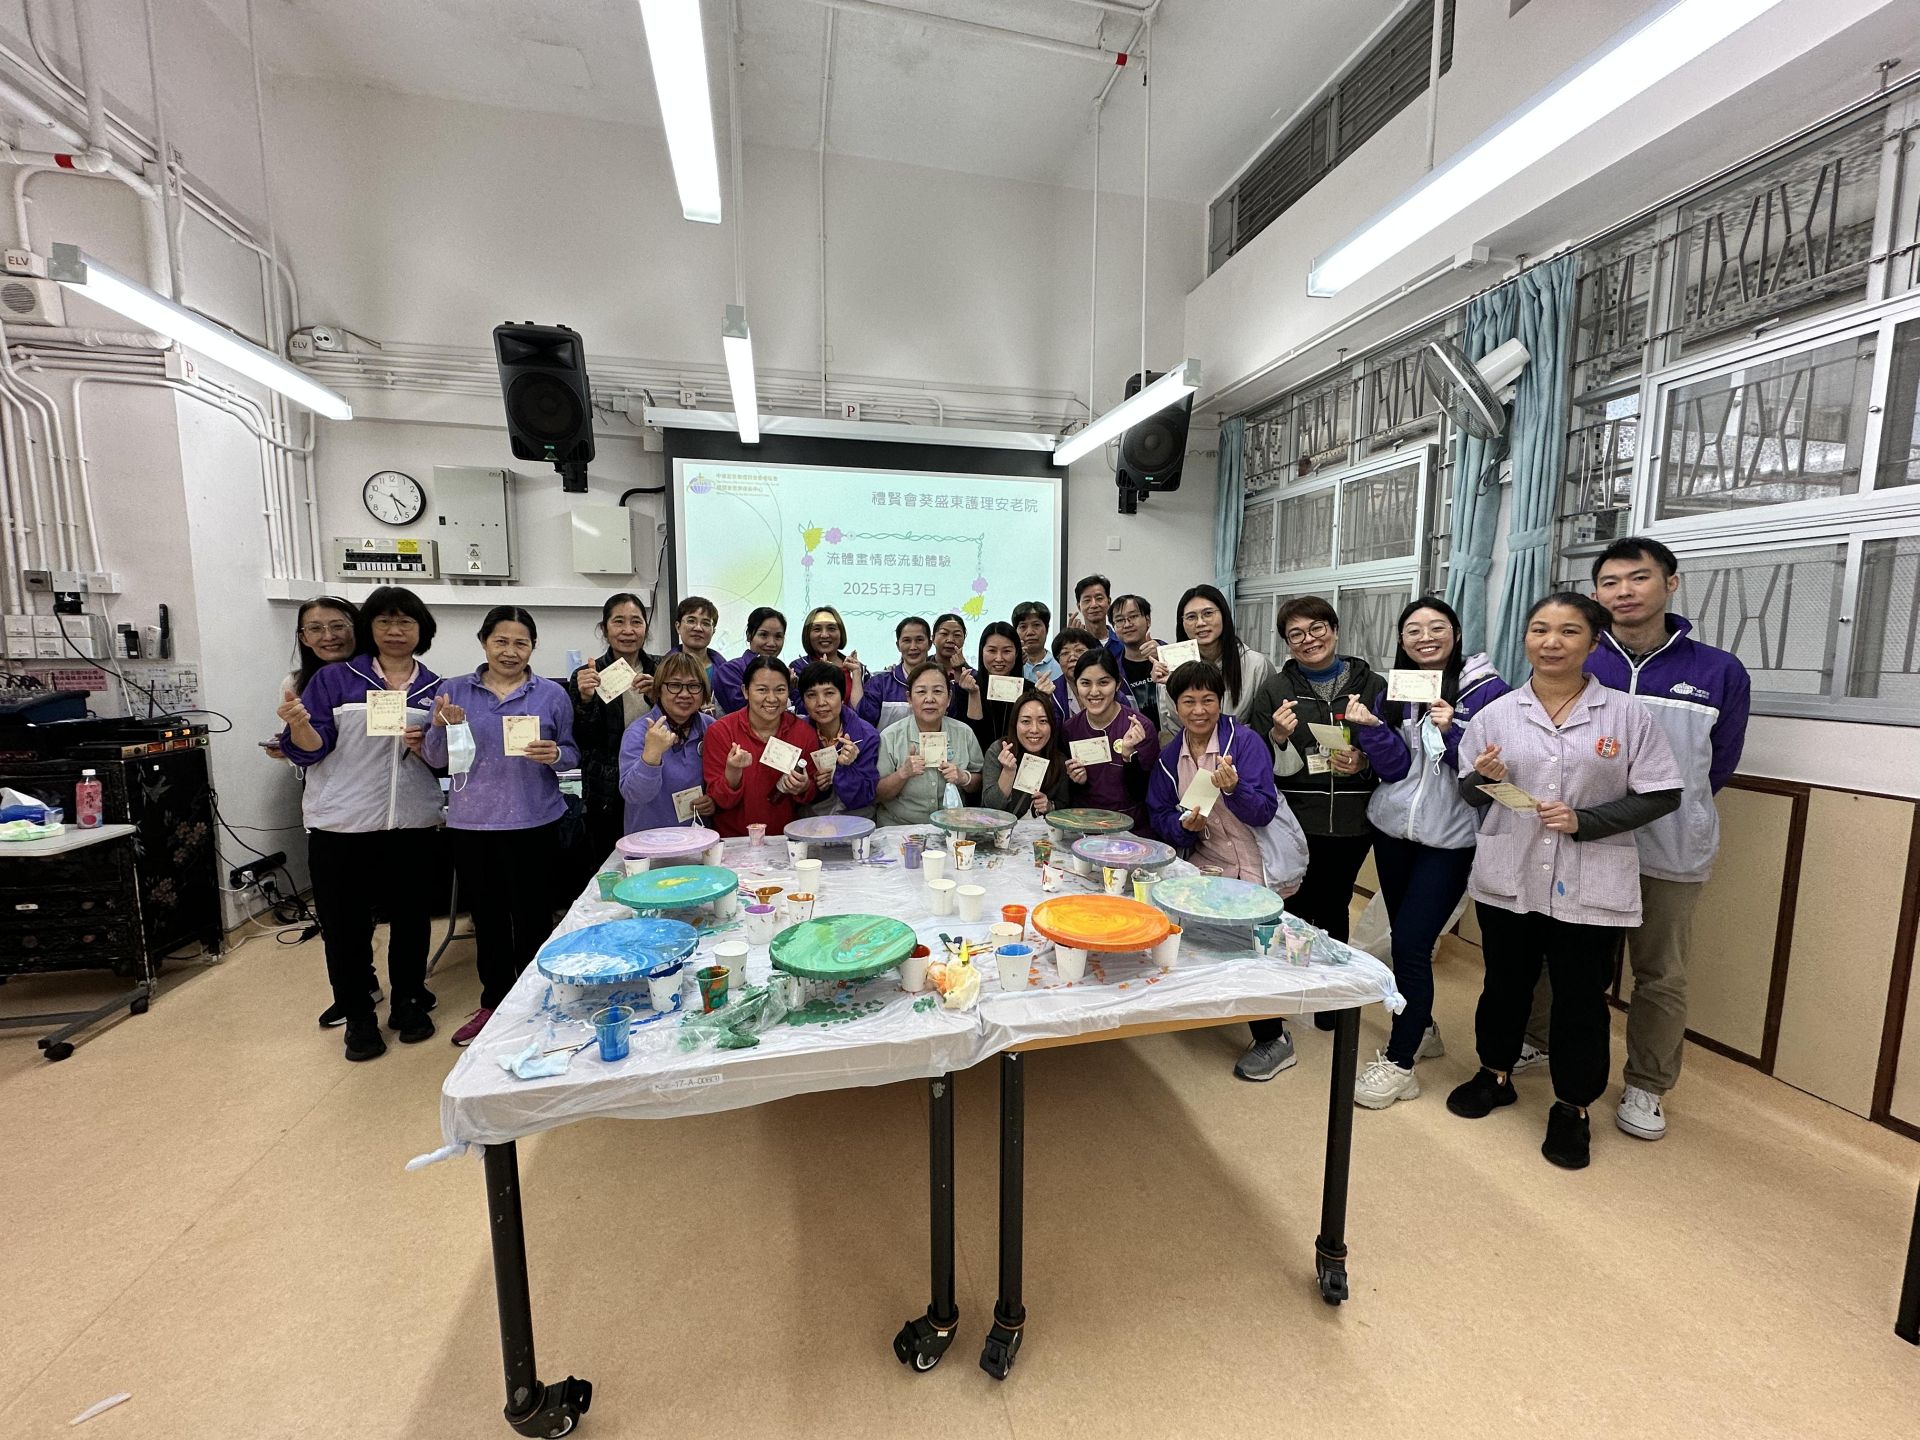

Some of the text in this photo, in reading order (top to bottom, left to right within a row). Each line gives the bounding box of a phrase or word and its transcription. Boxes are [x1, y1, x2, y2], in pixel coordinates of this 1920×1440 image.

[8, 255, 29, 266] ELV
[292, 341, 308, 349] ELV
[185, 360, 193, 379] P
[685, 392, 692, 402] P
[847, 405, 855, 417] P
[871, 491, 1039, 513] 禮賢會葵盛東護理安老院
[826, 551, 952, 568] 流體畫情感流動體驗
[843, 582, 936, 597] 2025年3月7日
